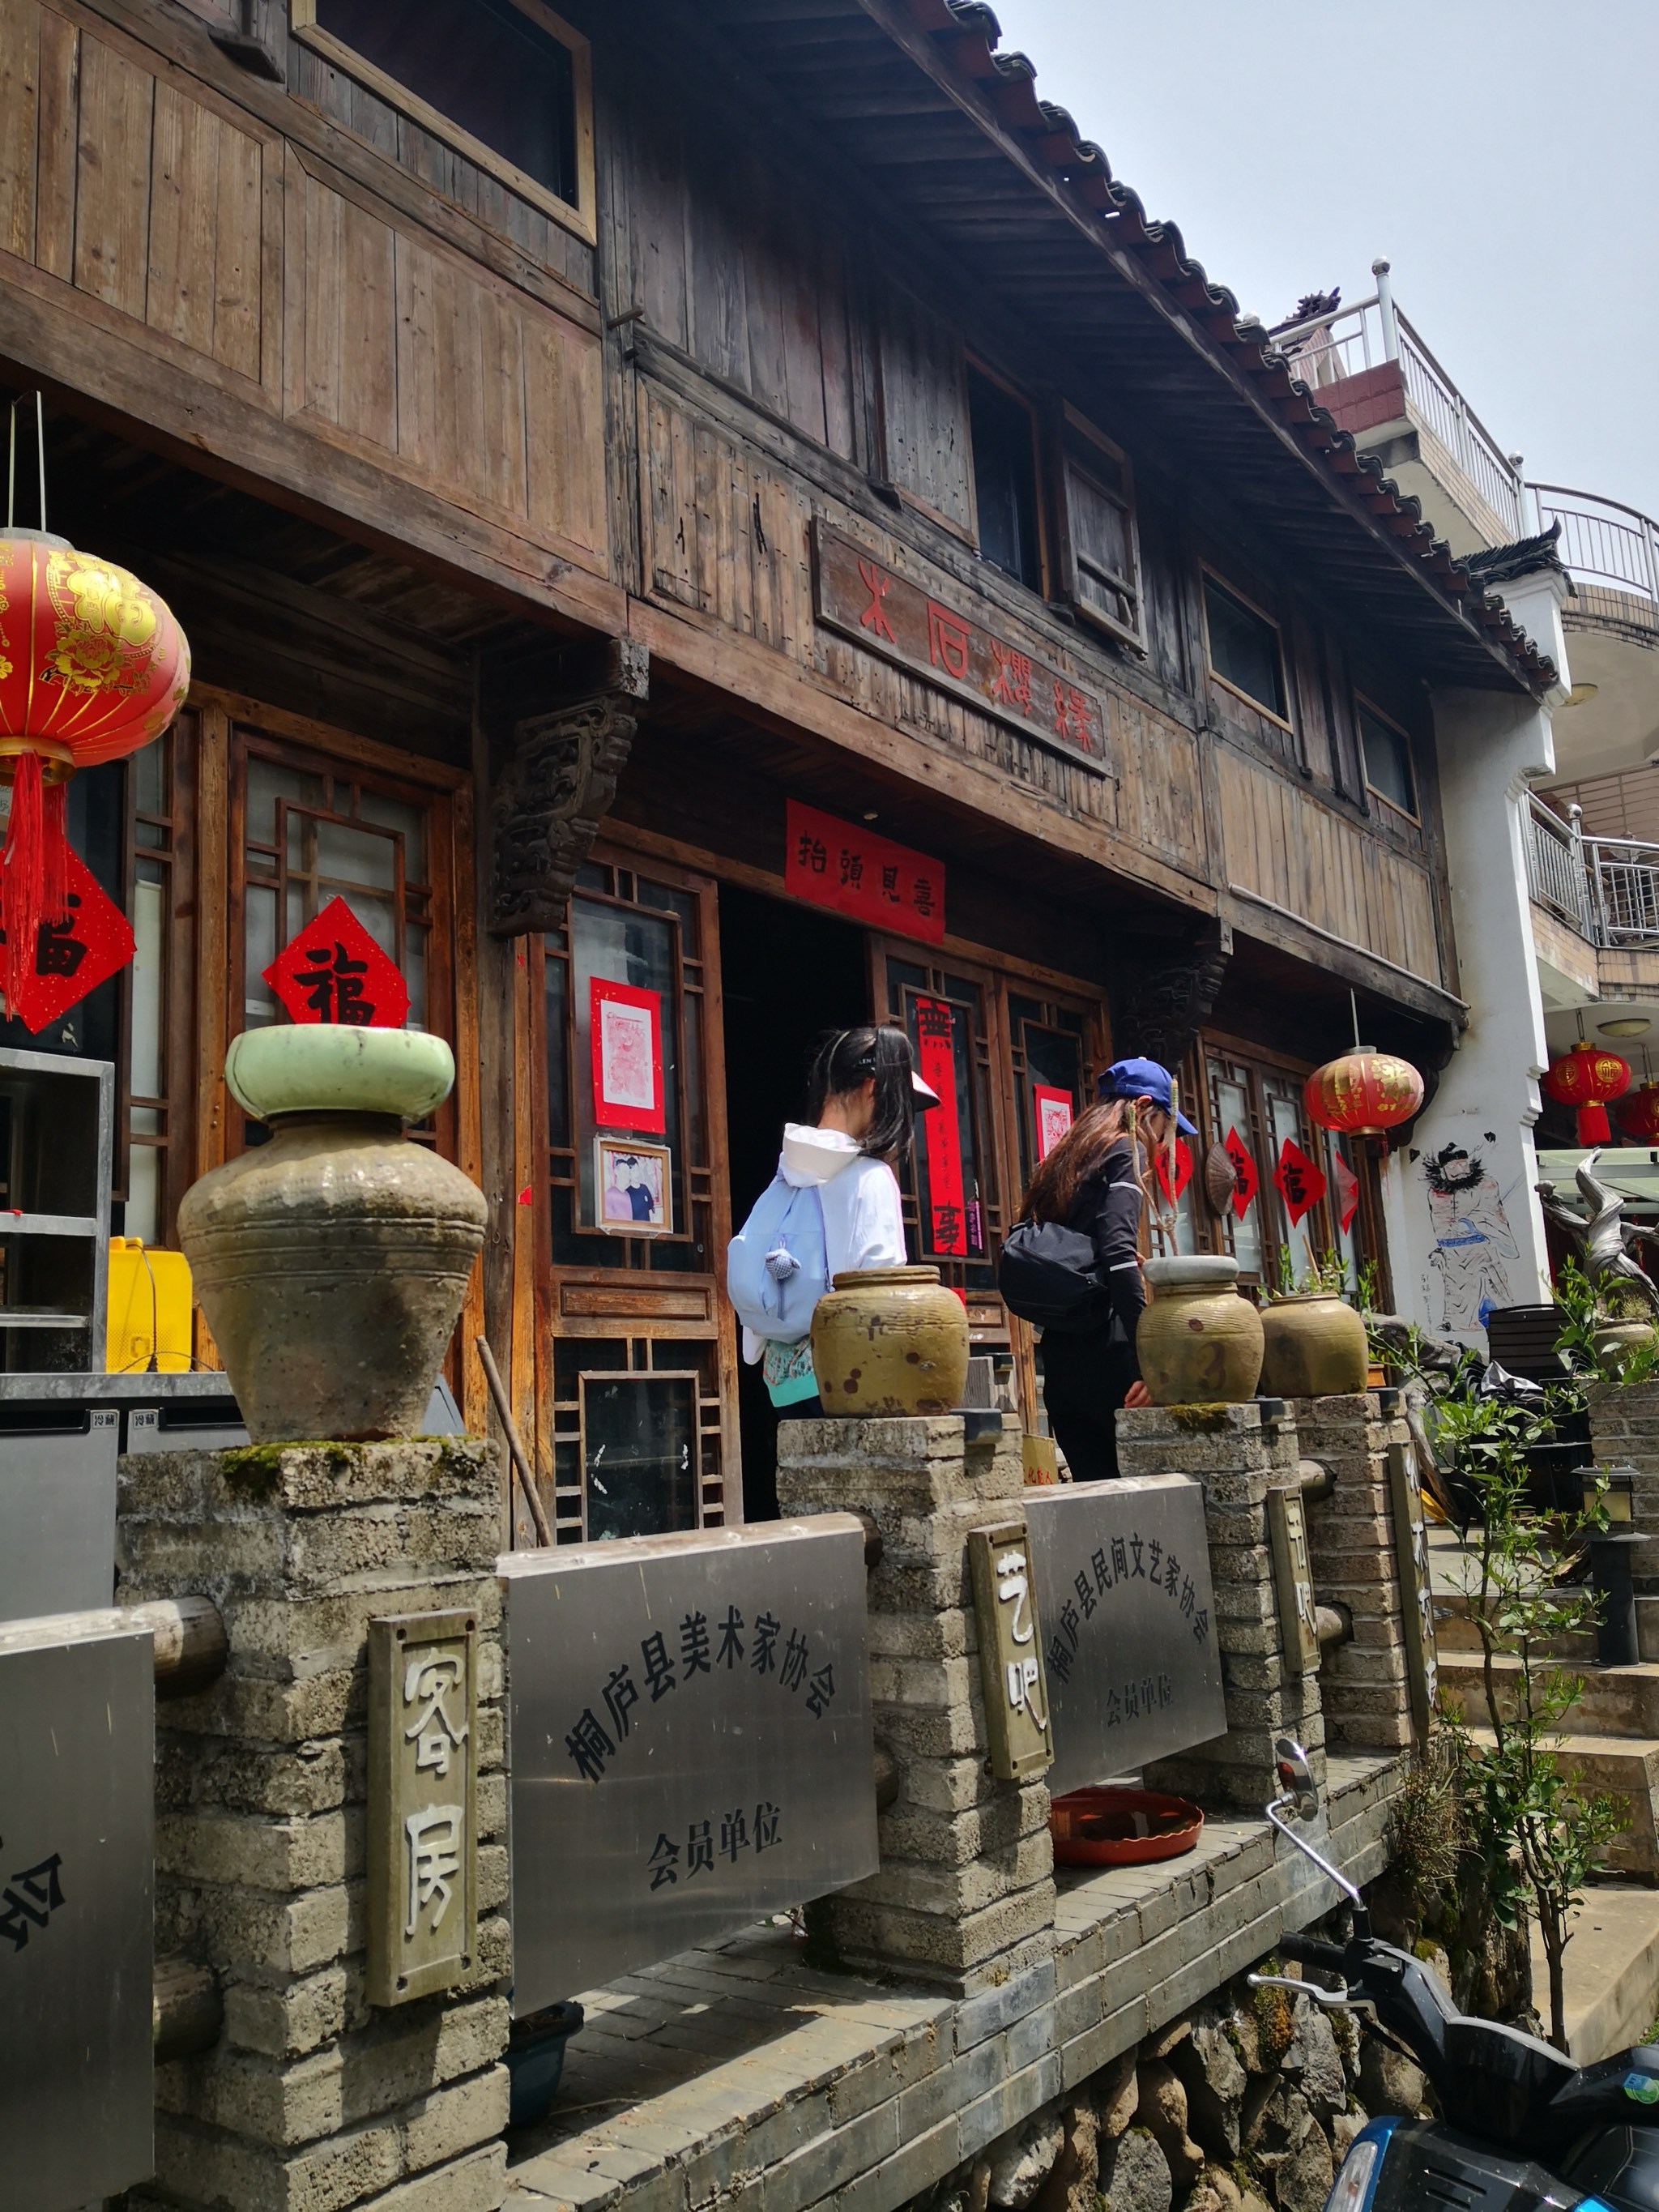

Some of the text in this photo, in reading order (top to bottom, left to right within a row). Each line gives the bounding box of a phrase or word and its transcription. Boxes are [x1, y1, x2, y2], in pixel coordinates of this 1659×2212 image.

[294, 942, 376, 1026] 福
[1282, 1161, 1307, 1204] 福
[94, 1414, 114, 1426] 冷藏
[134, 1414, 155, 1427] 冷藏
[1047, 1531, 1209, 1685] 桐庐县民间文艺家协会
[564, 1604, 836, 1783] 桐庐县美术家协会
[1106, 1673, 1175, 1728] 会员单位
[404, 1646, 468, 1938] 客房
[647, 1801, 783, 1892] 会员单位
